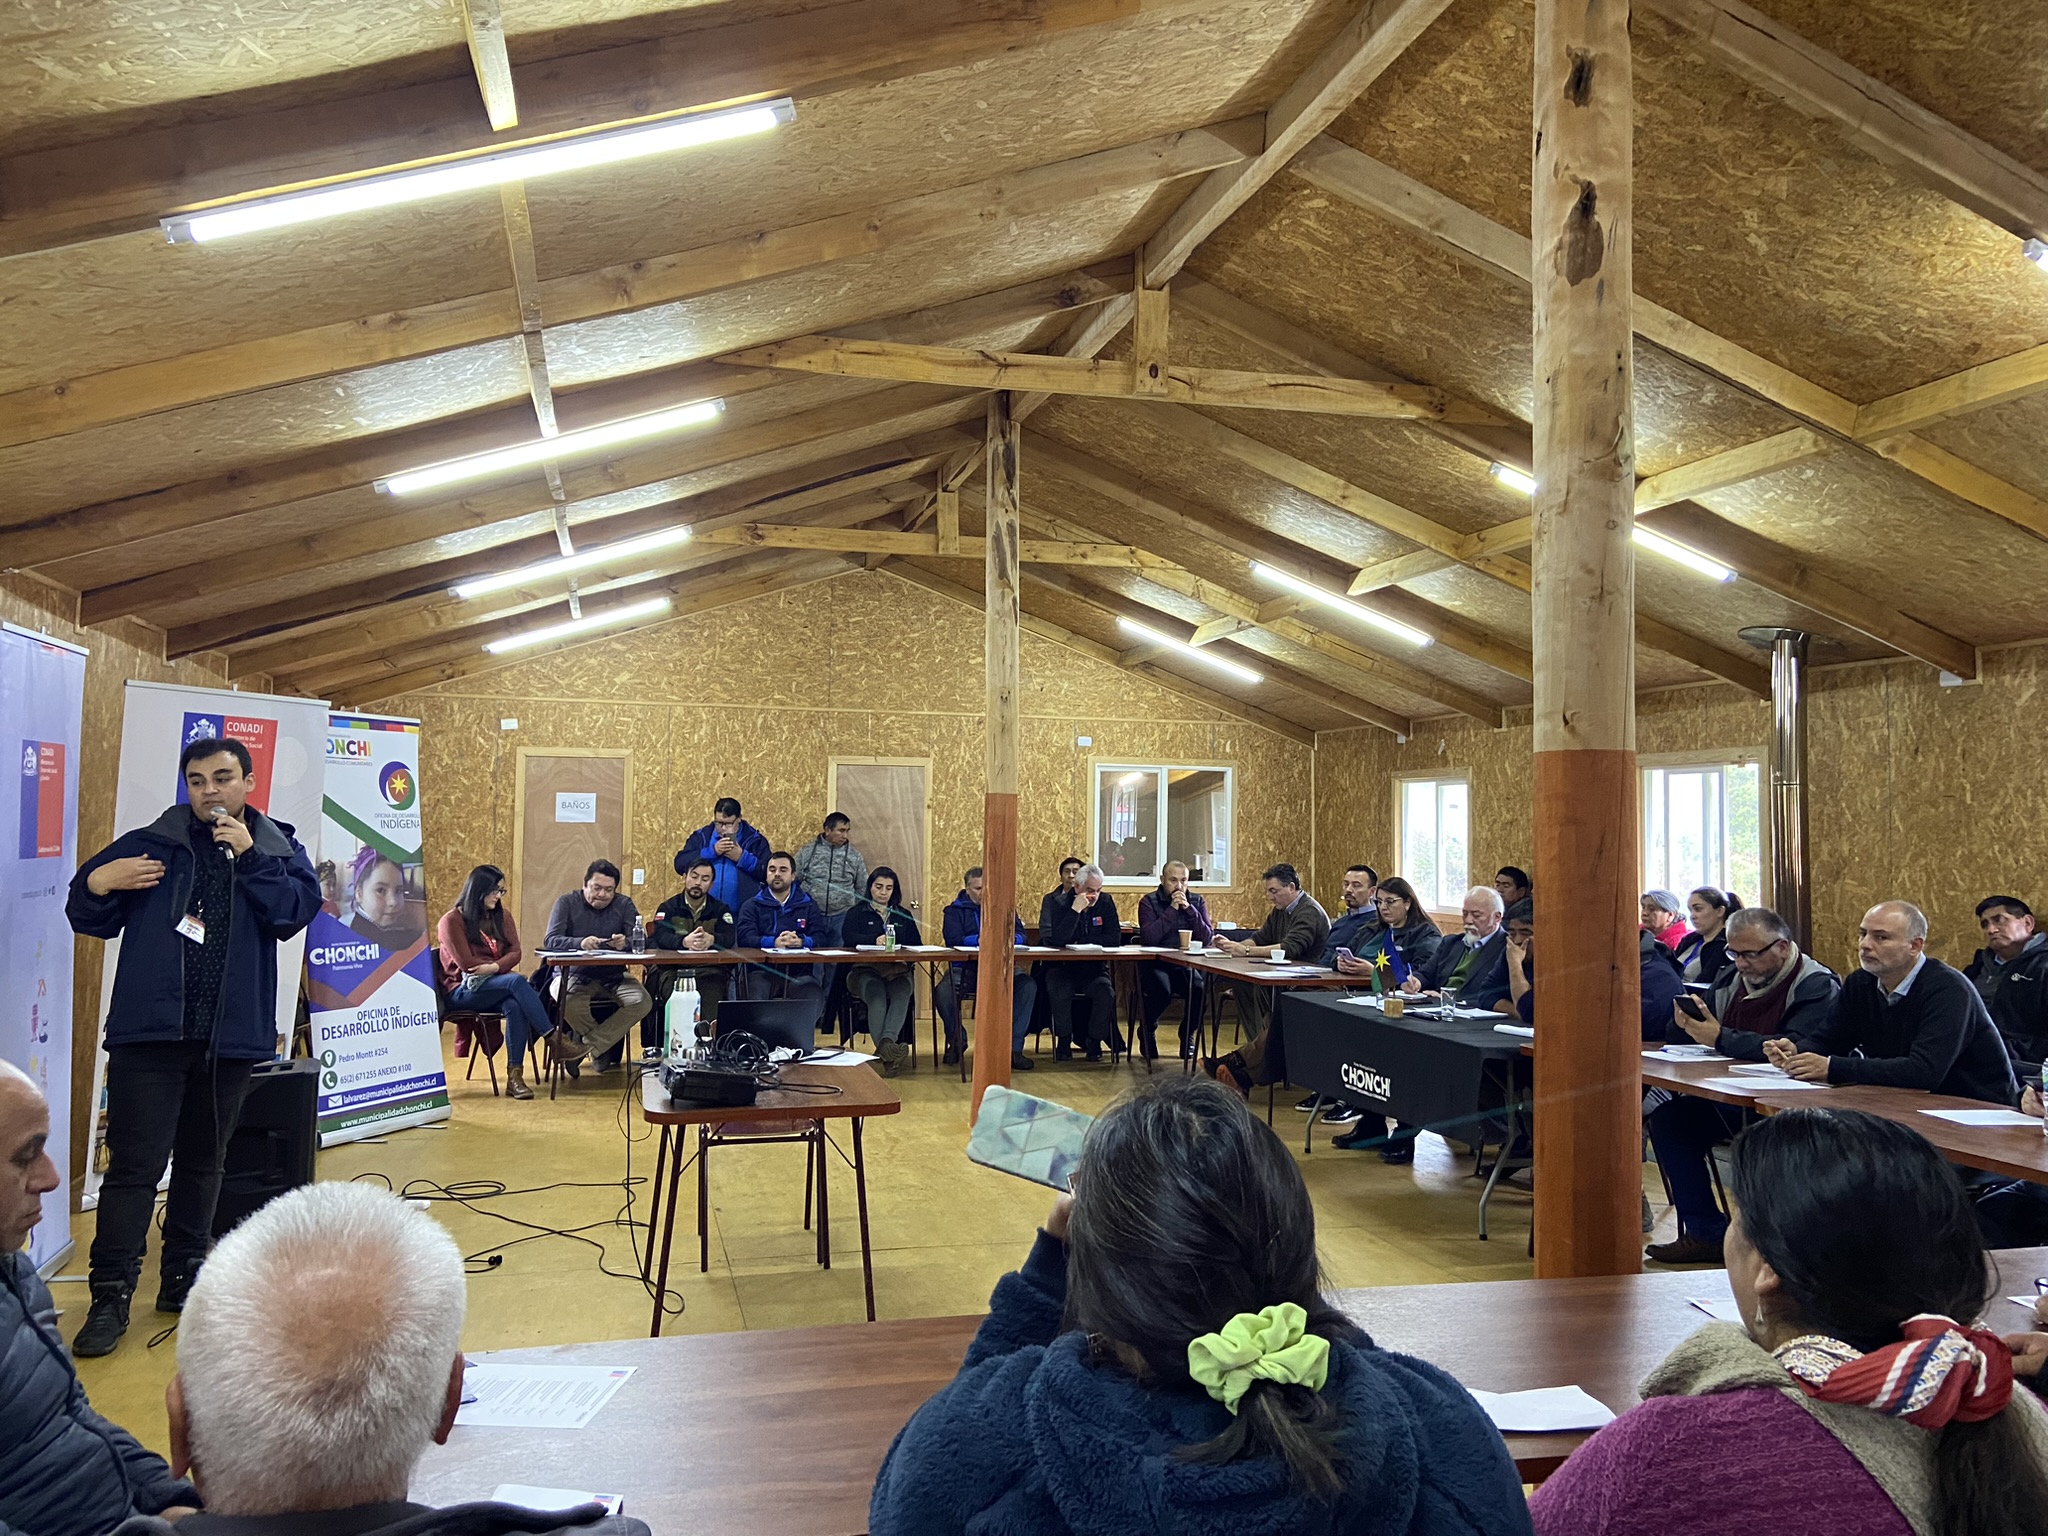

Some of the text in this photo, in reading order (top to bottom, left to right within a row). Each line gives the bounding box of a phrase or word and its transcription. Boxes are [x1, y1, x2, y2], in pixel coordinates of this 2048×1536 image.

[226, 722, 263, 734] CONADI
[561, 800, 590, 809] BAÑOS
[310, 944, 379, 965] CHONCHI
[357, 1006, 400, 1021] OFICINA DE
[322, 1019, 389, 1040] DESARROLLO
[339, 1048, 388, 1063] Pedro Montt #254
[340, 1064, 412, 1084] 65(2) 671255 ANEXO #100
[340, 1100, 432, 1128] www.municipalidadchonchi.cl
